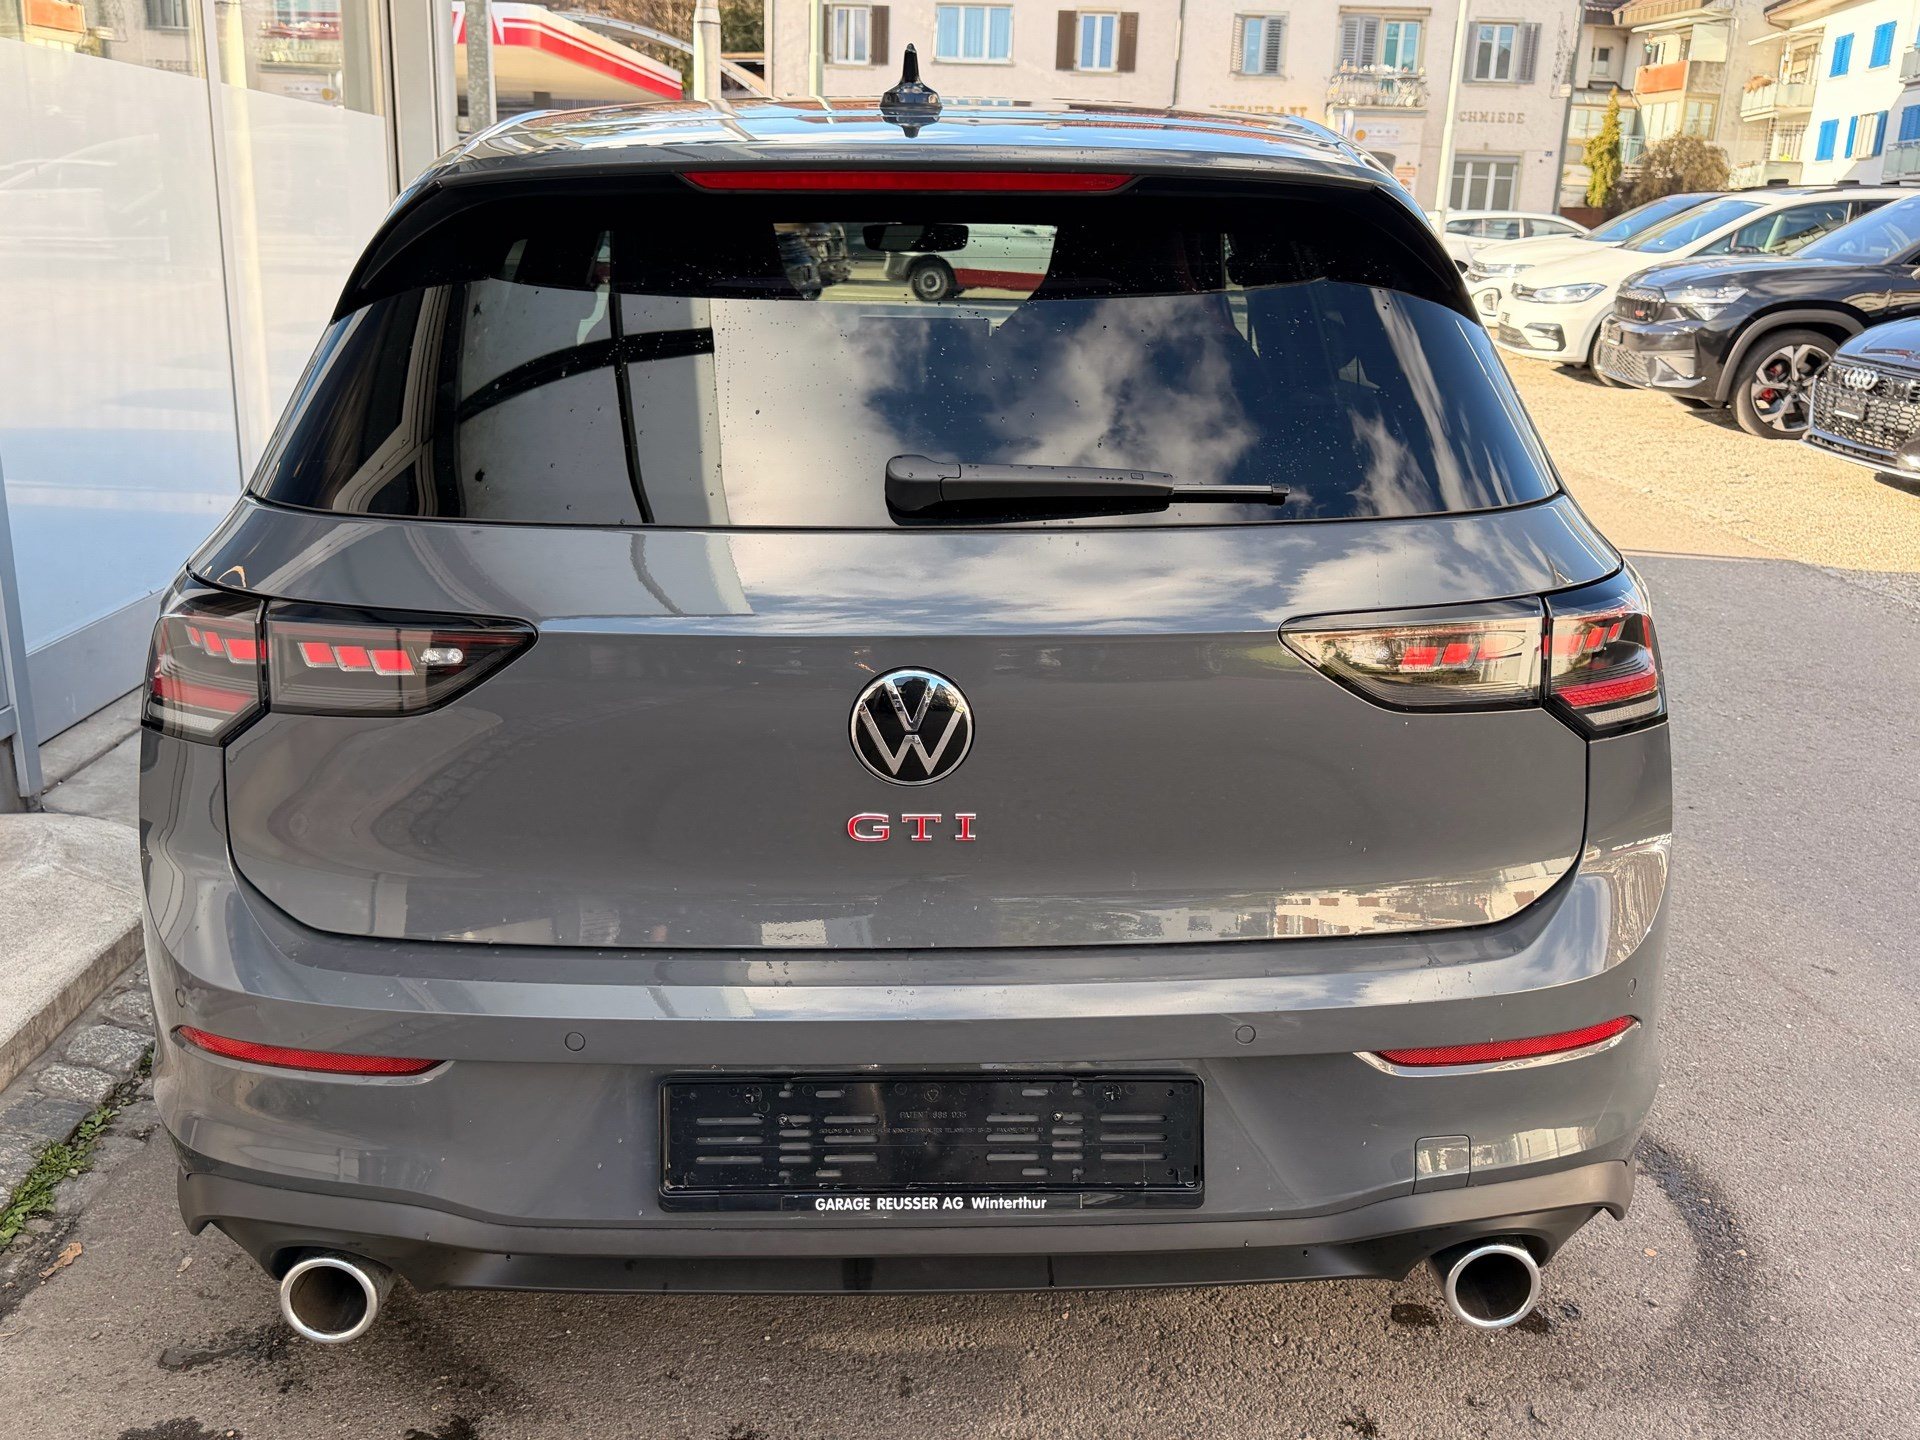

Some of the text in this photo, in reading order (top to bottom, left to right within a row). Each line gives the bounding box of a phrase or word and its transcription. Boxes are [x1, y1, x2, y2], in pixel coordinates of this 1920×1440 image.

[1458, 111, 1526, 125] CHMIEDE
[851, 669, 973, 783] VW
[847, 812, 977, 842] GTI
[815, 1196, 1048, 1211] GARAGE REUSSER AG Winterthur
